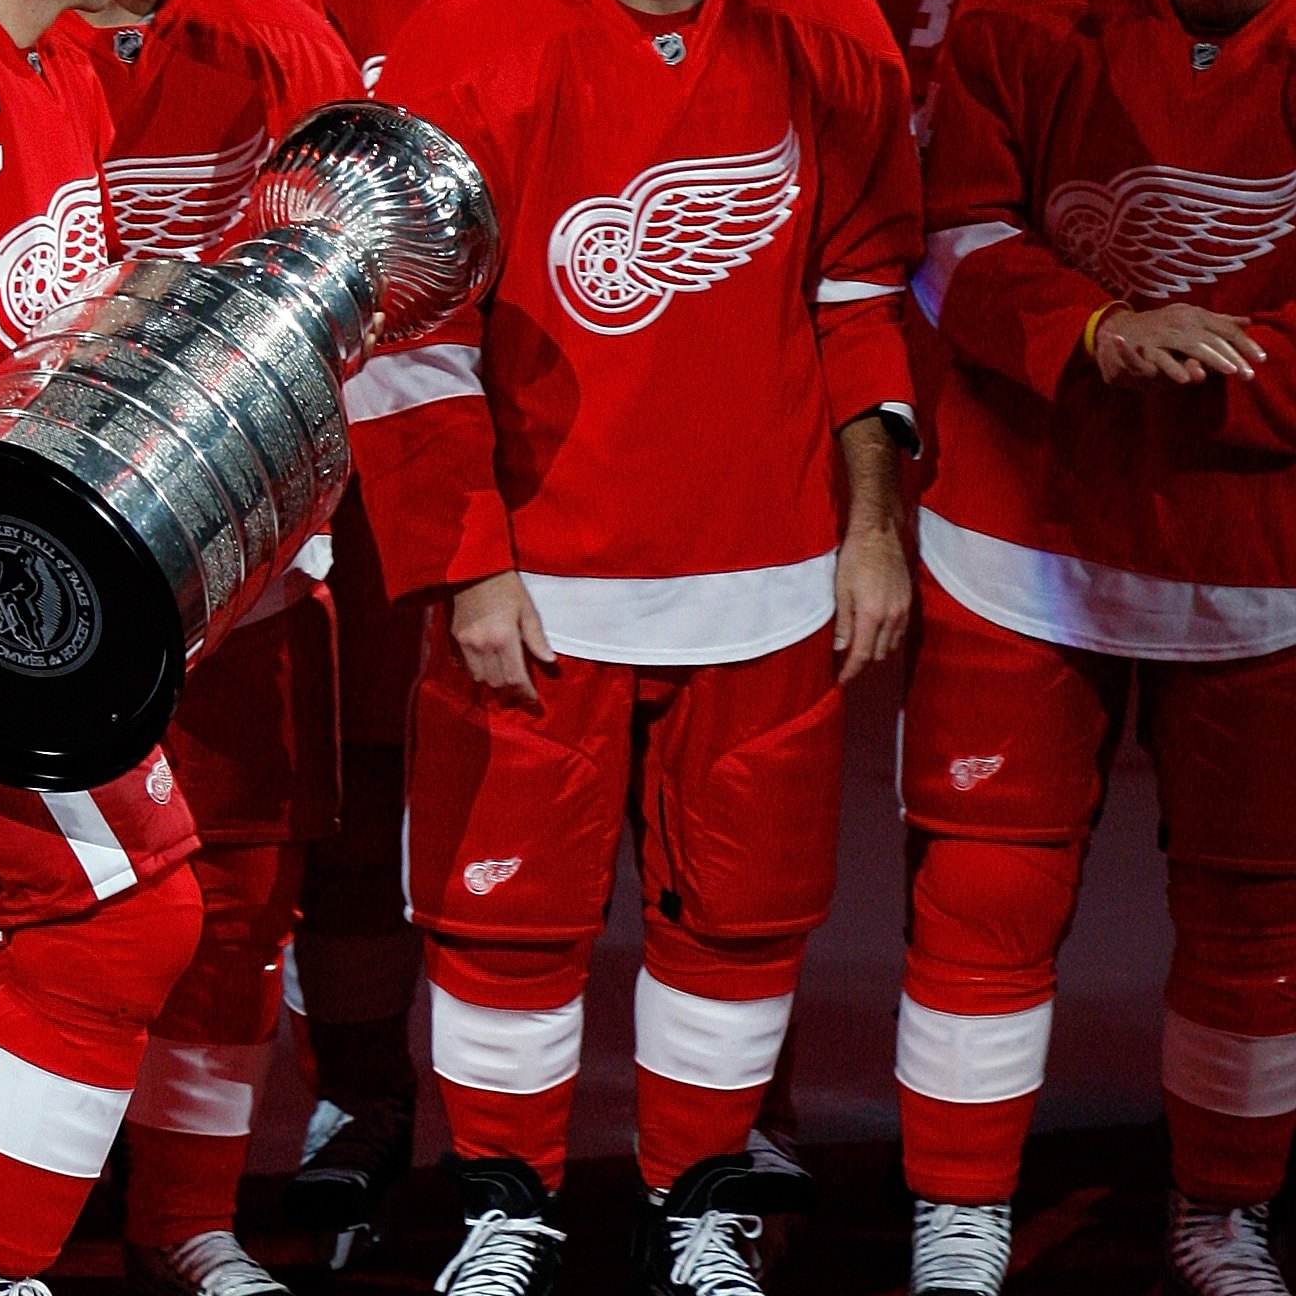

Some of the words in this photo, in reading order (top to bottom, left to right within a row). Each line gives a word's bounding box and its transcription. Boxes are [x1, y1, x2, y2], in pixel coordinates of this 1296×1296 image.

[23, 530, 56, 559] HALL
[66, 572, 90, 607] FAME
[59, 616, 91, 662] HOCKEY
